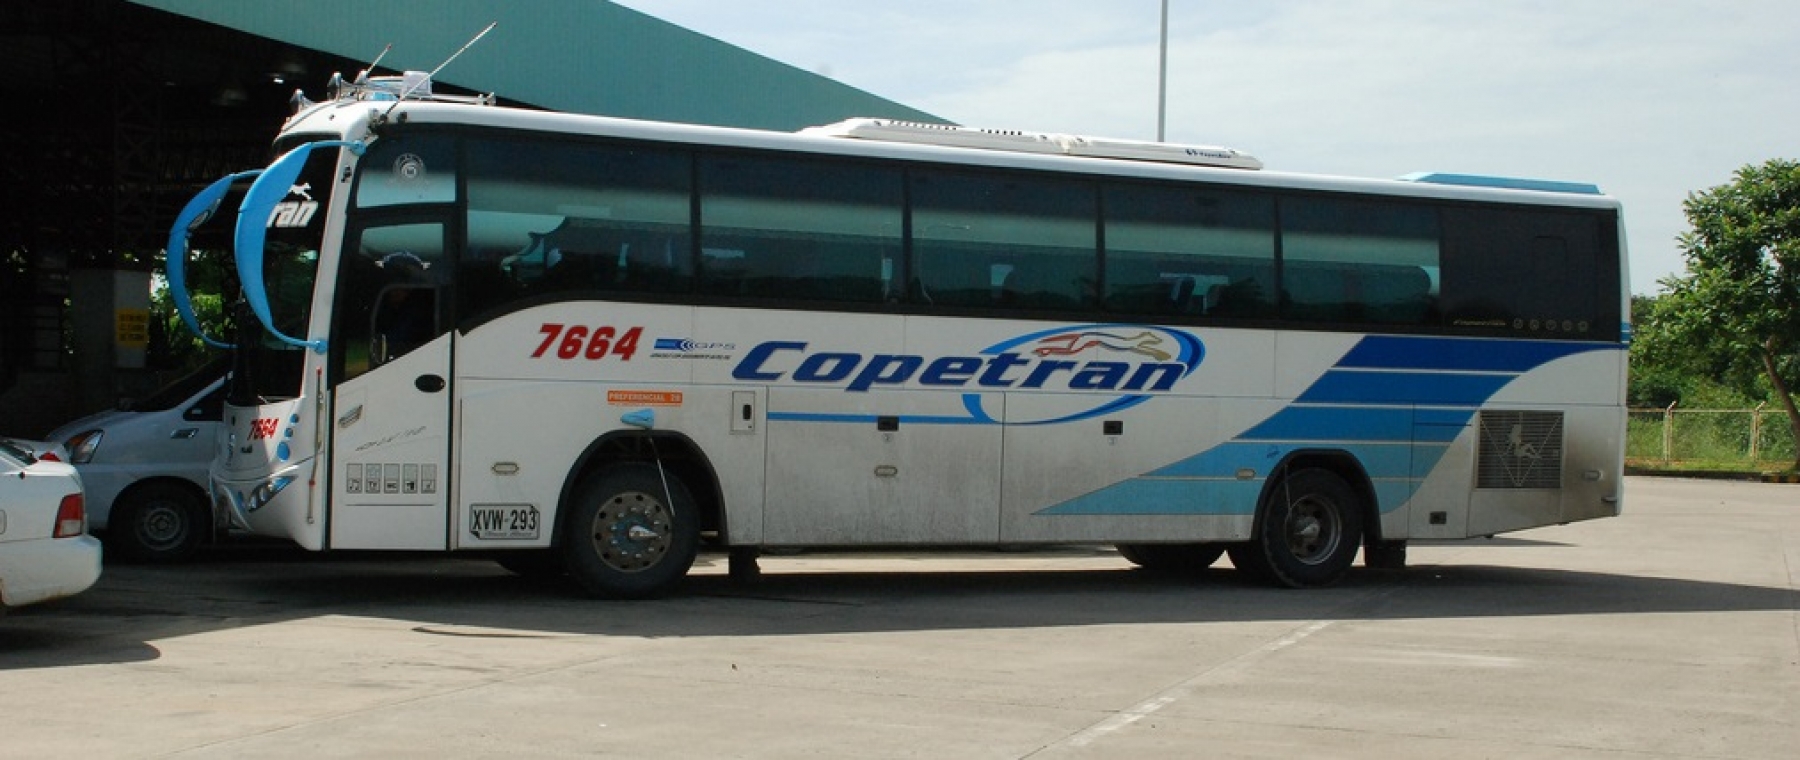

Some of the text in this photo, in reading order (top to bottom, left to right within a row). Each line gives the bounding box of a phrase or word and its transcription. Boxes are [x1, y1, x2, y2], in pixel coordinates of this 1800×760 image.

[530, 323, 644, 361] 7664
[694, 342, 736, 351] GPS
[732, 339, 1186, 392] Copetran
[609, 392, 665, 403] PREFERENCIAL
[247, 417, 279, 440] 7664
[472, 509, 536, 531] XVW-293
